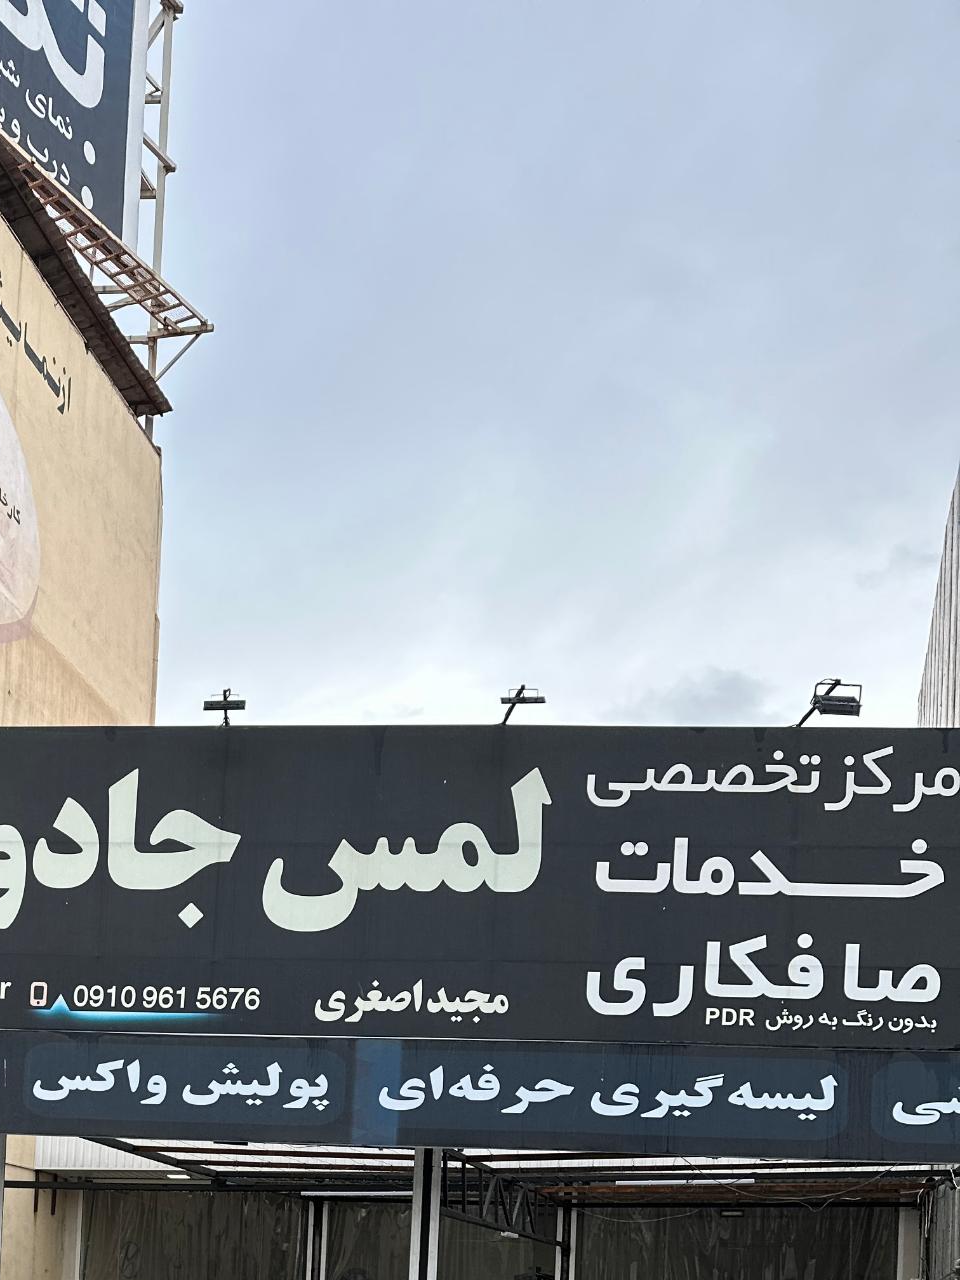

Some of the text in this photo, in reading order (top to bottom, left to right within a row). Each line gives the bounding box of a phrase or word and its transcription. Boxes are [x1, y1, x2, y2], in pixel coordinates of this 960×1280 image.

[587, 750, 821, 807] تخصصی
[262, 767, 552, 932] لمس
[595, 837, 945, 898] خدمات
[73, 984, 261, 1011] 0910 961 5676
[705, 1007, 937, 1034] بدون رنگ به روش PDR
[181, 1062, 329, 1112] پولیش
